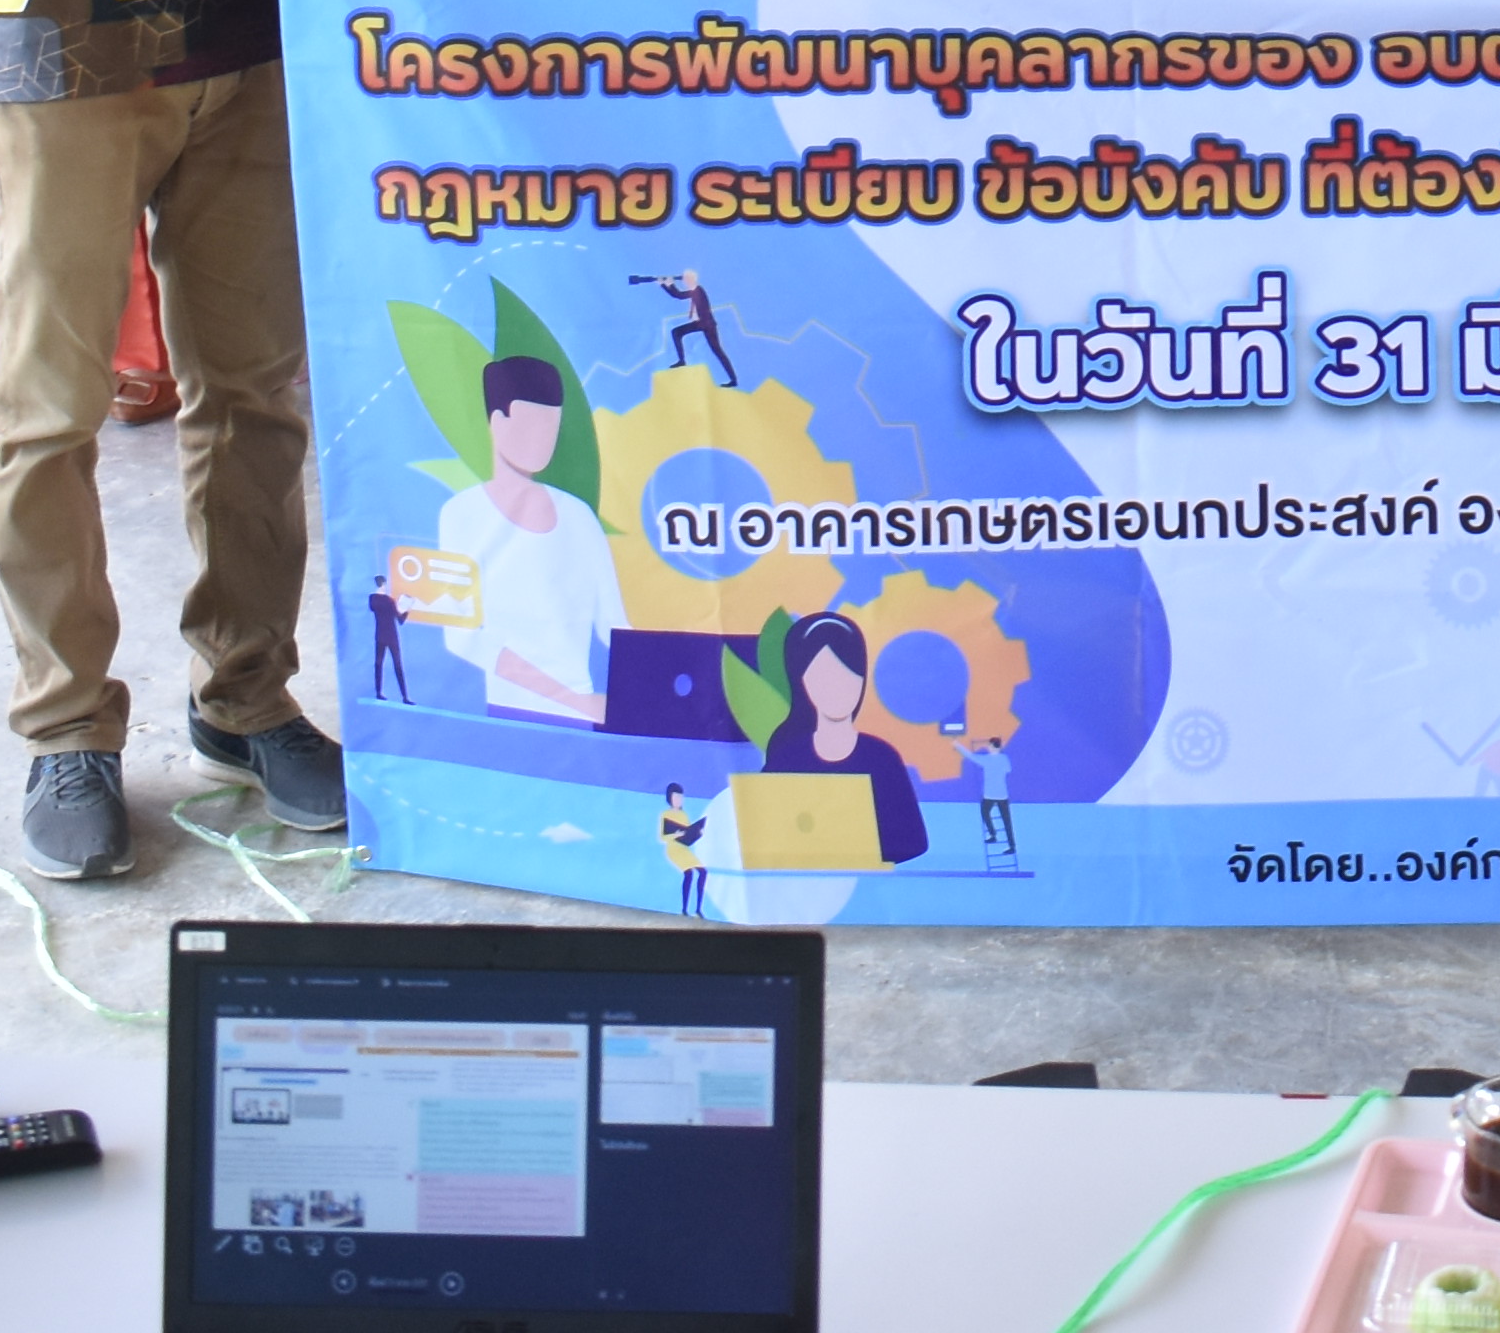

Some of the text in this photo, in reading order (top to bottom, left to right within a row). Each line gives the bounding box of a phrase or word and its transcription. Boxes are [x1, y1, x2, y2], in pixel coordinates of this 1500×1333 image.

[350, 8, 1357, 115] โครงการพัฒนาบุคลากรของ
[374, 162, 670, 243] กฎหมาย
[691, 138, 959, 224] ระเบียบ
[976, 134, 1285, 221] ข้อบังคับ
[959, 268, 1290, 410] ในวันที่
[1317, 314, 1433, 403] 31
[662, 505, 718, 548] ณ
[739, 479, 1440, 549] อาคารเกษตรเอนกประสงค์
